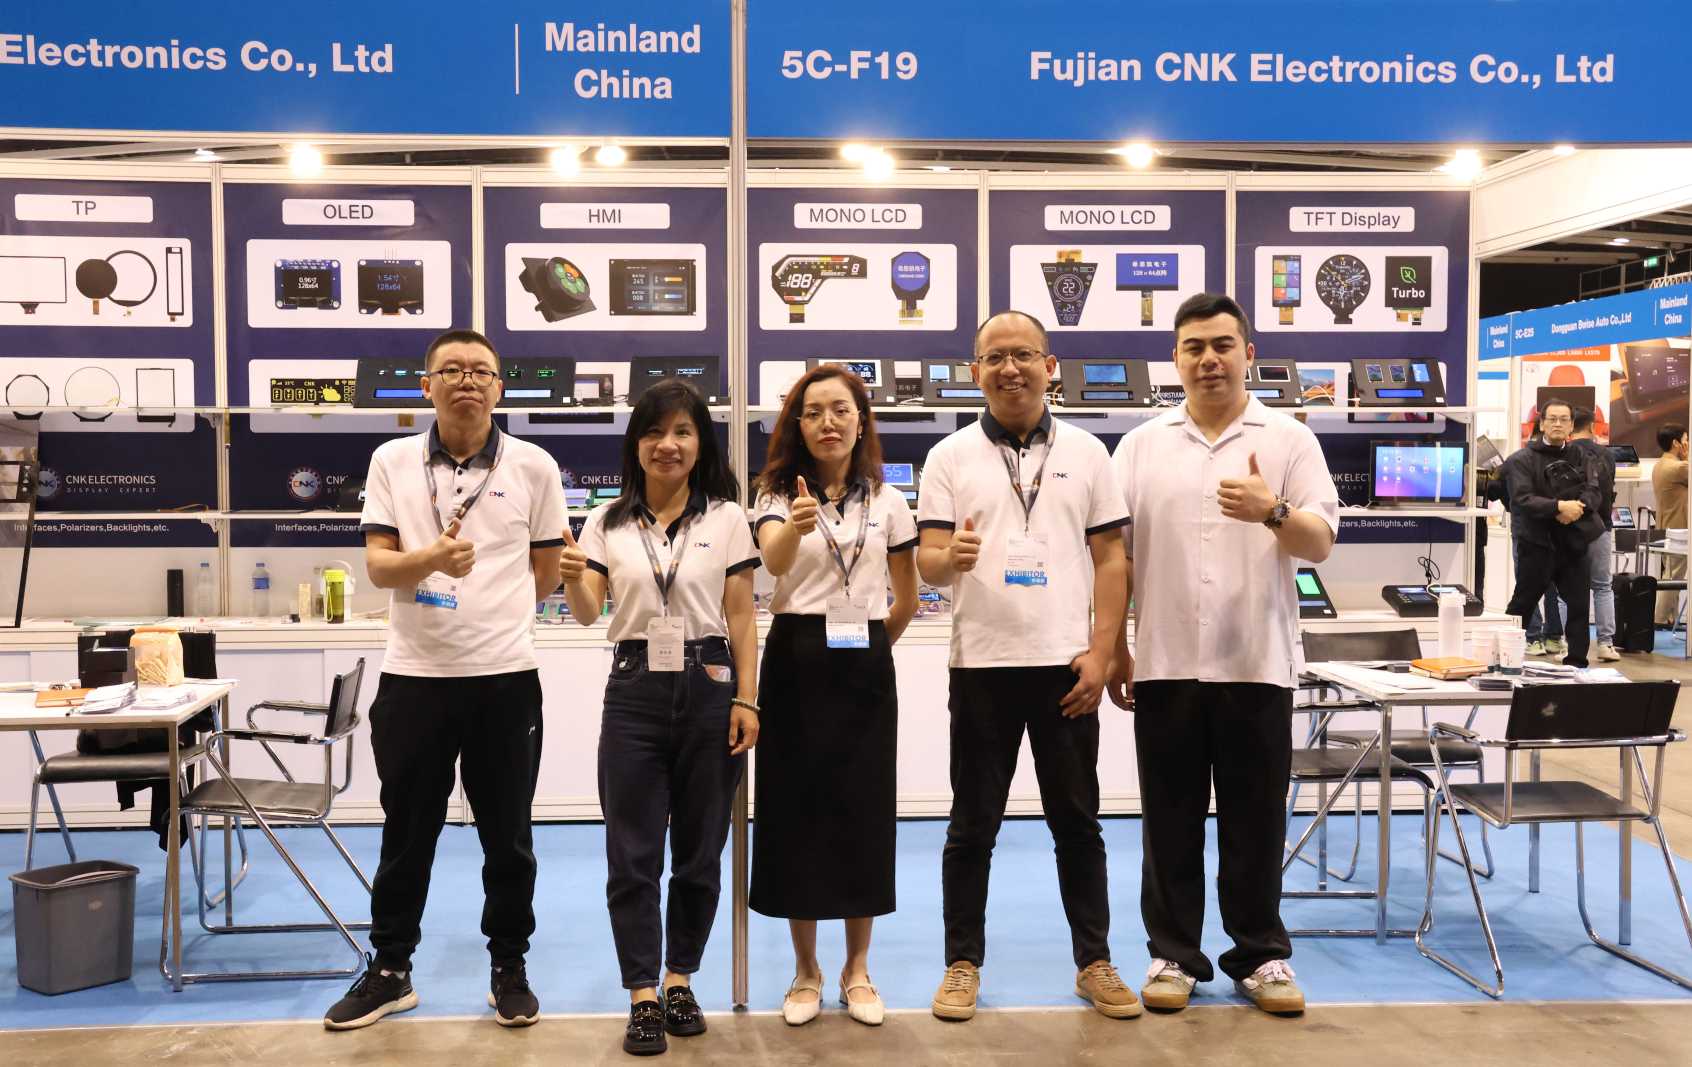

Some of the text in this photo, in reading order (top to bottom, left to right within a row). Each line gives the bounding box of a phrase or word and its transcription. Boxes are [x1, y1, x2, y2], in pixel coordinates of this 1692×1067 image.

[544, 22, 701, 53] Mainland
[0, 34, 393, 78] Electronics Co., Ltd
[781, 49, 918, 80] 5C-F19
[1029, 50, 1615, 88] Fujian CNK Electronics Co., Ltd
[573, 69, 673, 99] China
[71, 201, 97, 216] TP
[323, 204, 374, 219] OLED
[588, 208, 622, 224] HMI
[809, 208, 907, 223] MONO LCD
[1059, 210, 1156, 225] MONO LCD
[1303, 212, 1401, 230] TFT Display
[1391, 287, 1426, 299] Turbo
[1659, 294, 1689, 310] Mainland
[1664, 312, 1683, 325] China
